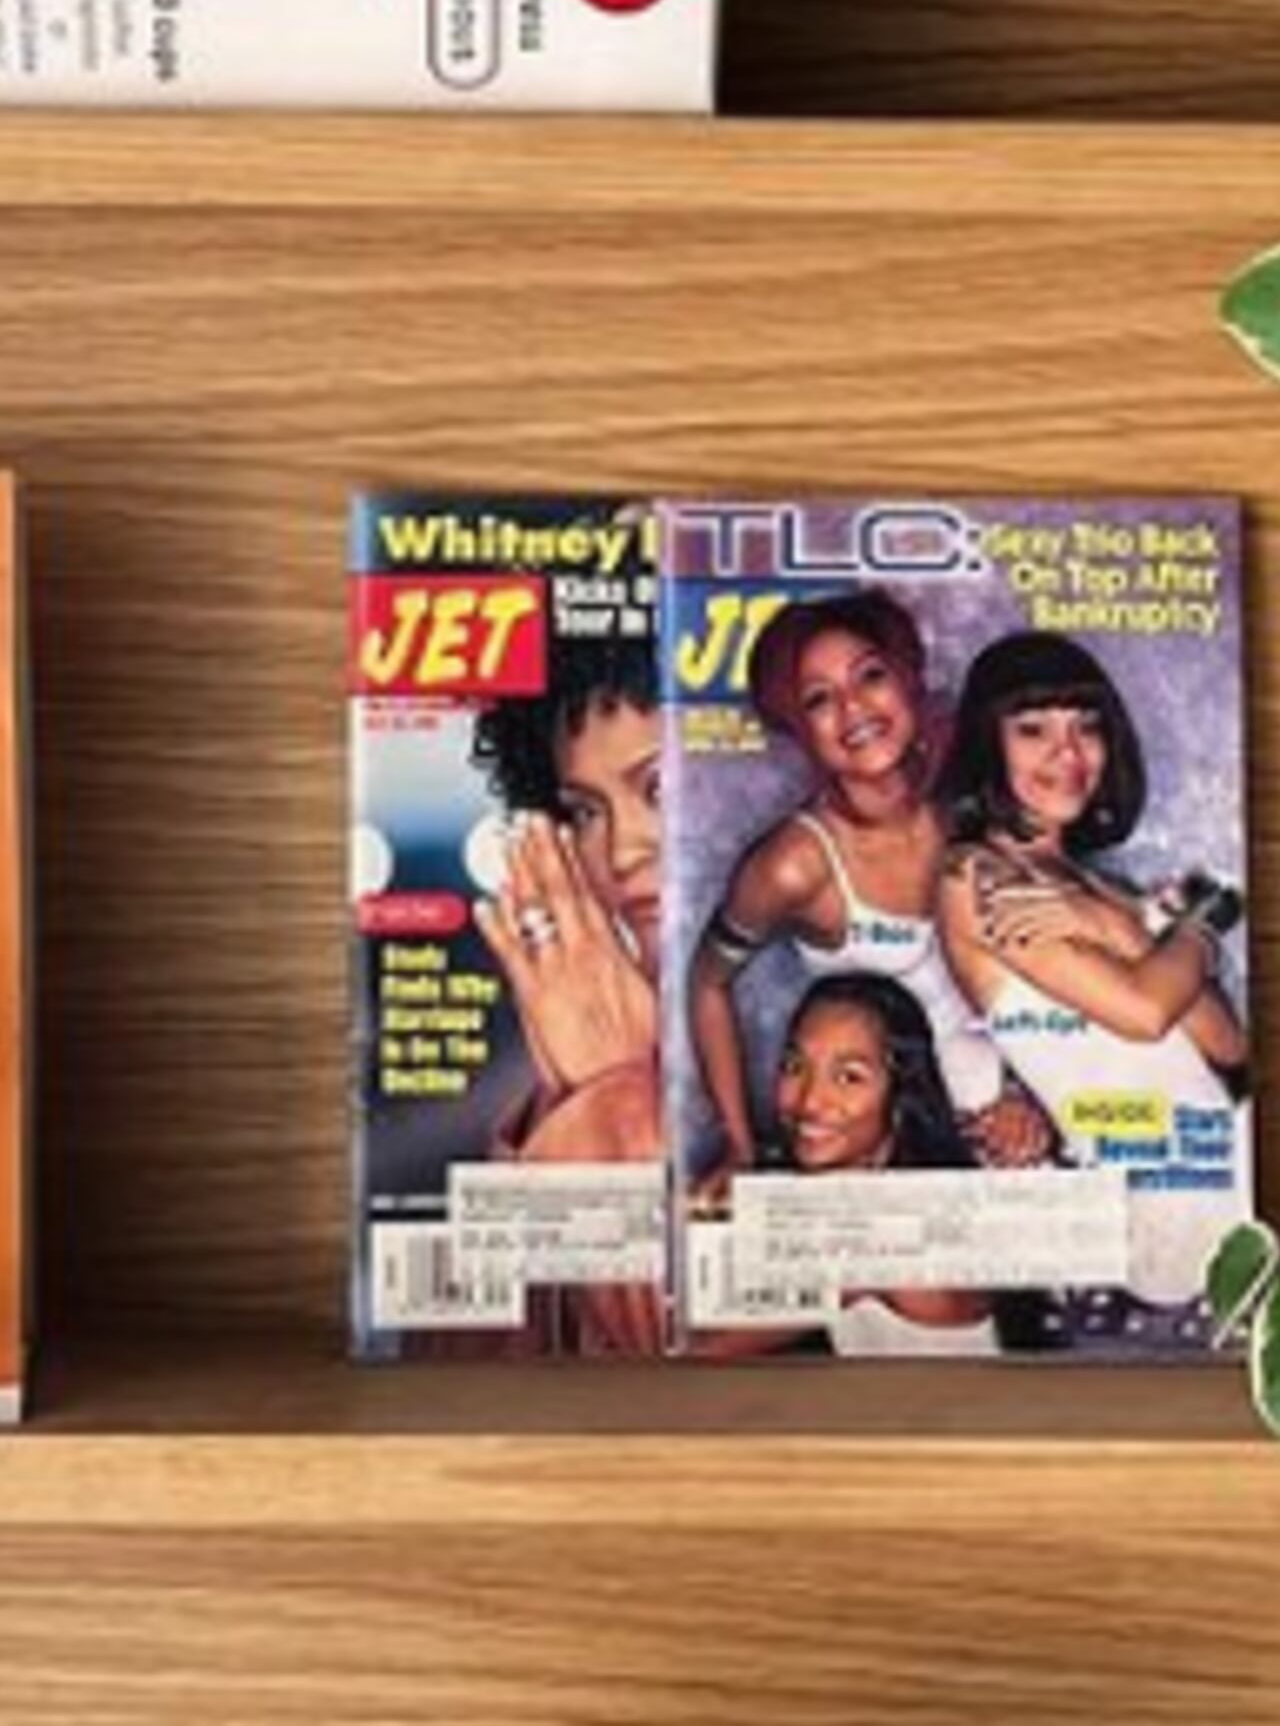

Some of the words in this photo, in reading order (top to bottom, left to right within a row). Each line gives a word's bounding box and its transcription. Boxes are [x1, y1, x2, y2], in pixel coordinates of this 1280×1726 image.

[378, 515, 630, 572] Whitney
[1139, 522, 1220, 559] Back
[1010, 561, 1062, 592] On
[1066, 560, 1128, 597] Top
[361, 587, 538, 686] JET
